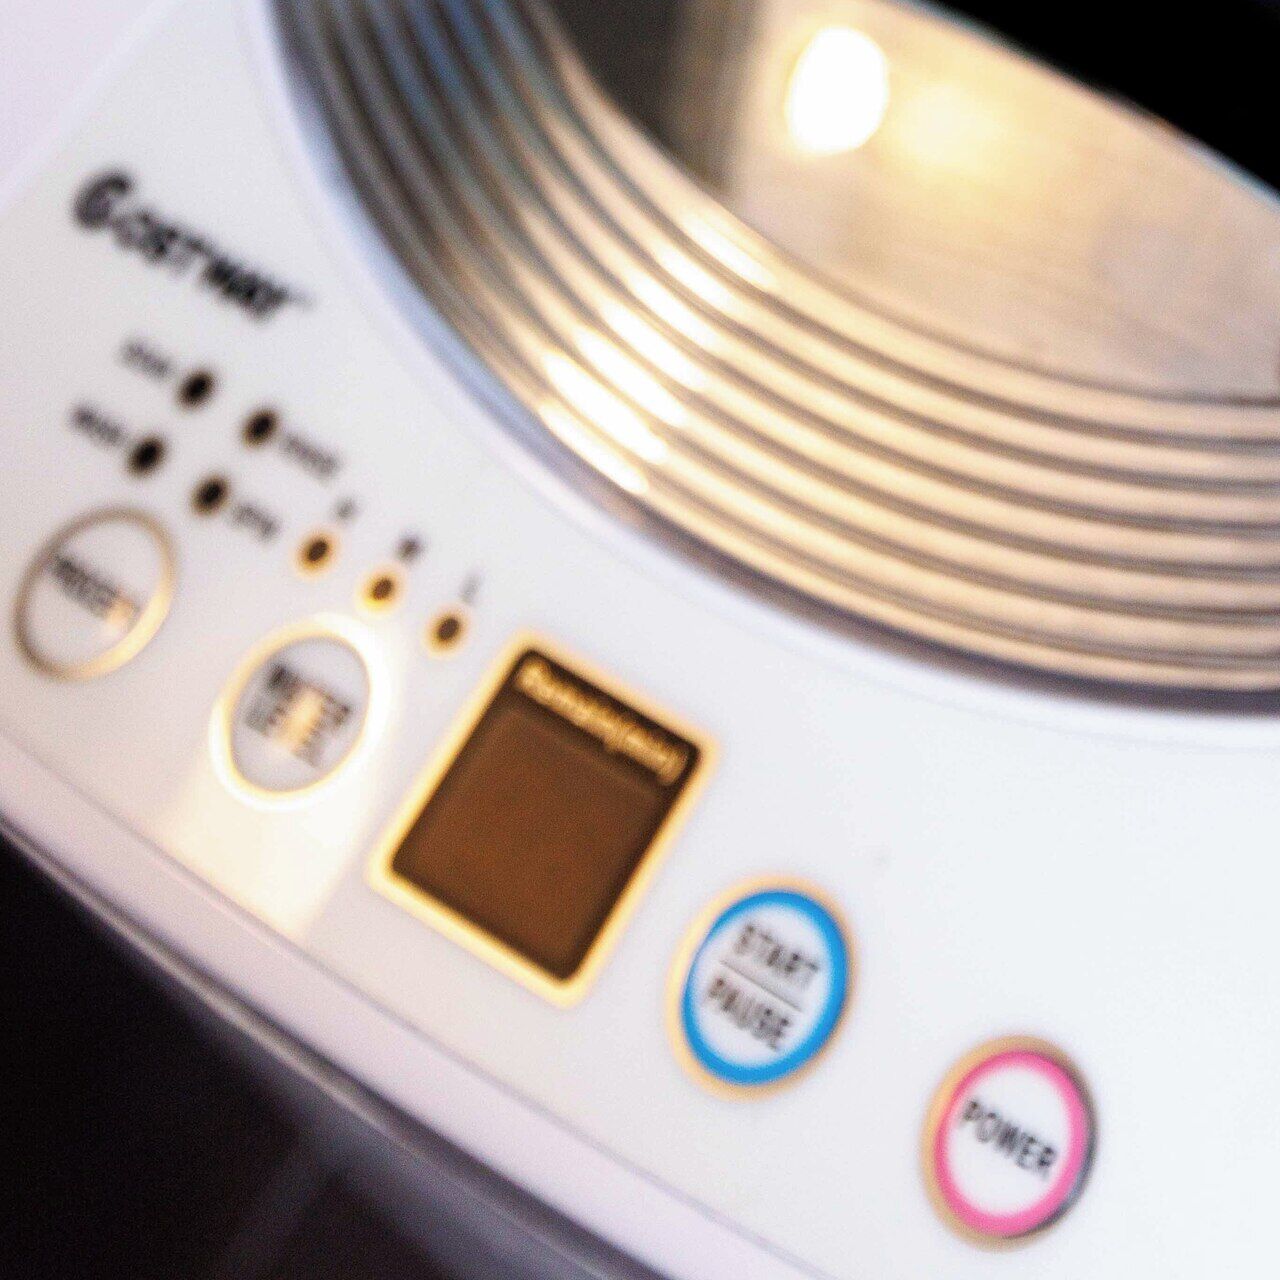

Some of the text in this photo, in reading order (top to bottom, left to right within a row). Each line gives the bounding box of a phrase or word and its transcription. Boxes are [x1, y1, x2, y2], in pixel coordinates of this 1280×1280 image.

[734, 923, 820, 990] START
[706, 976, 792, 1052] PAUSE
[960, 1097, 1058, 1181] POWER
